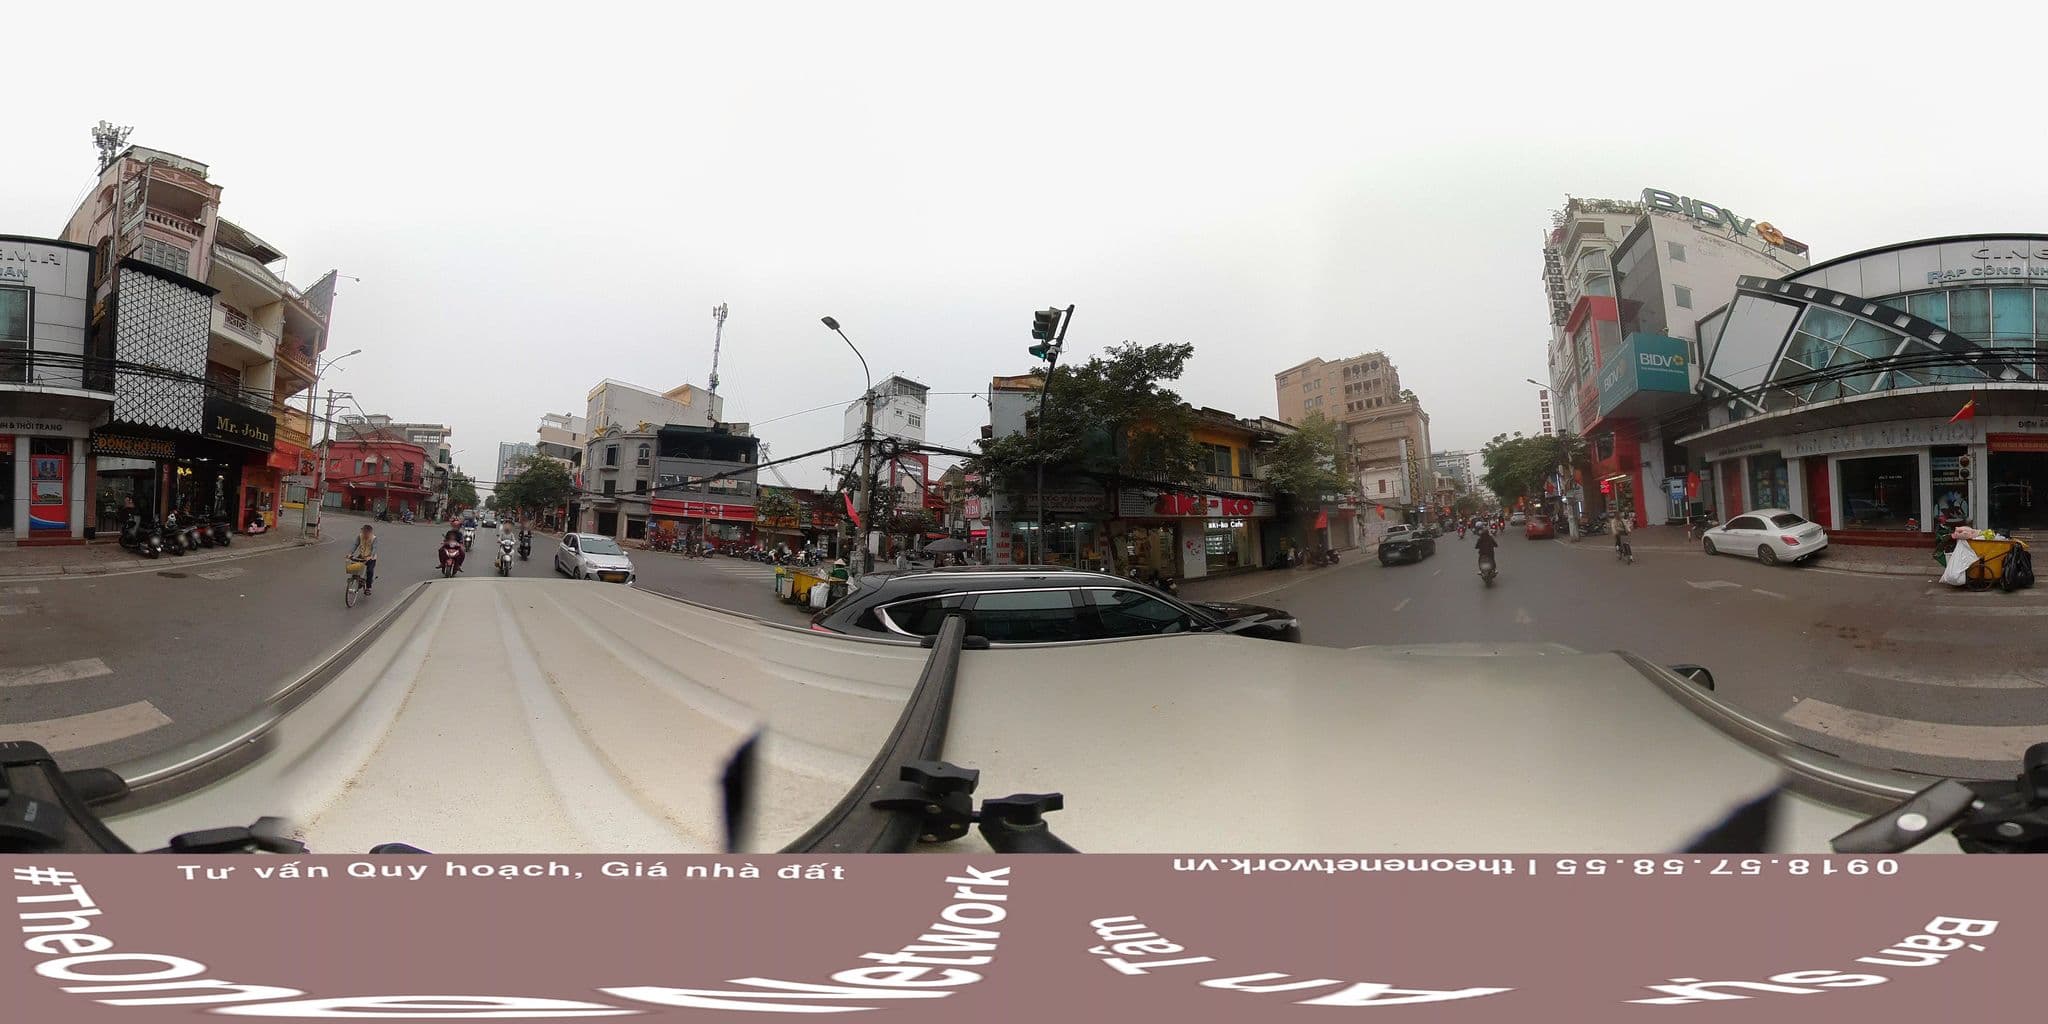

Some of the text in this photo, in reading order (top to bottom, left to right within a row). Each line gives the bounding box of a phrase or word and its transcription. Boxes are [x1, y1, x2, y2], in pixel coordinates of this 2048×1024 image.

[1641, 187, 1755, 237] BIDV
[1971, 264, 2021, 276] CÔNG
[1640, 352, 1672, 368] BIDV
[1603, 366, 1621, 393] BIDV
[35, 422, 63, 431] TRANG
[216, 416, 269, 442] Mr. John
